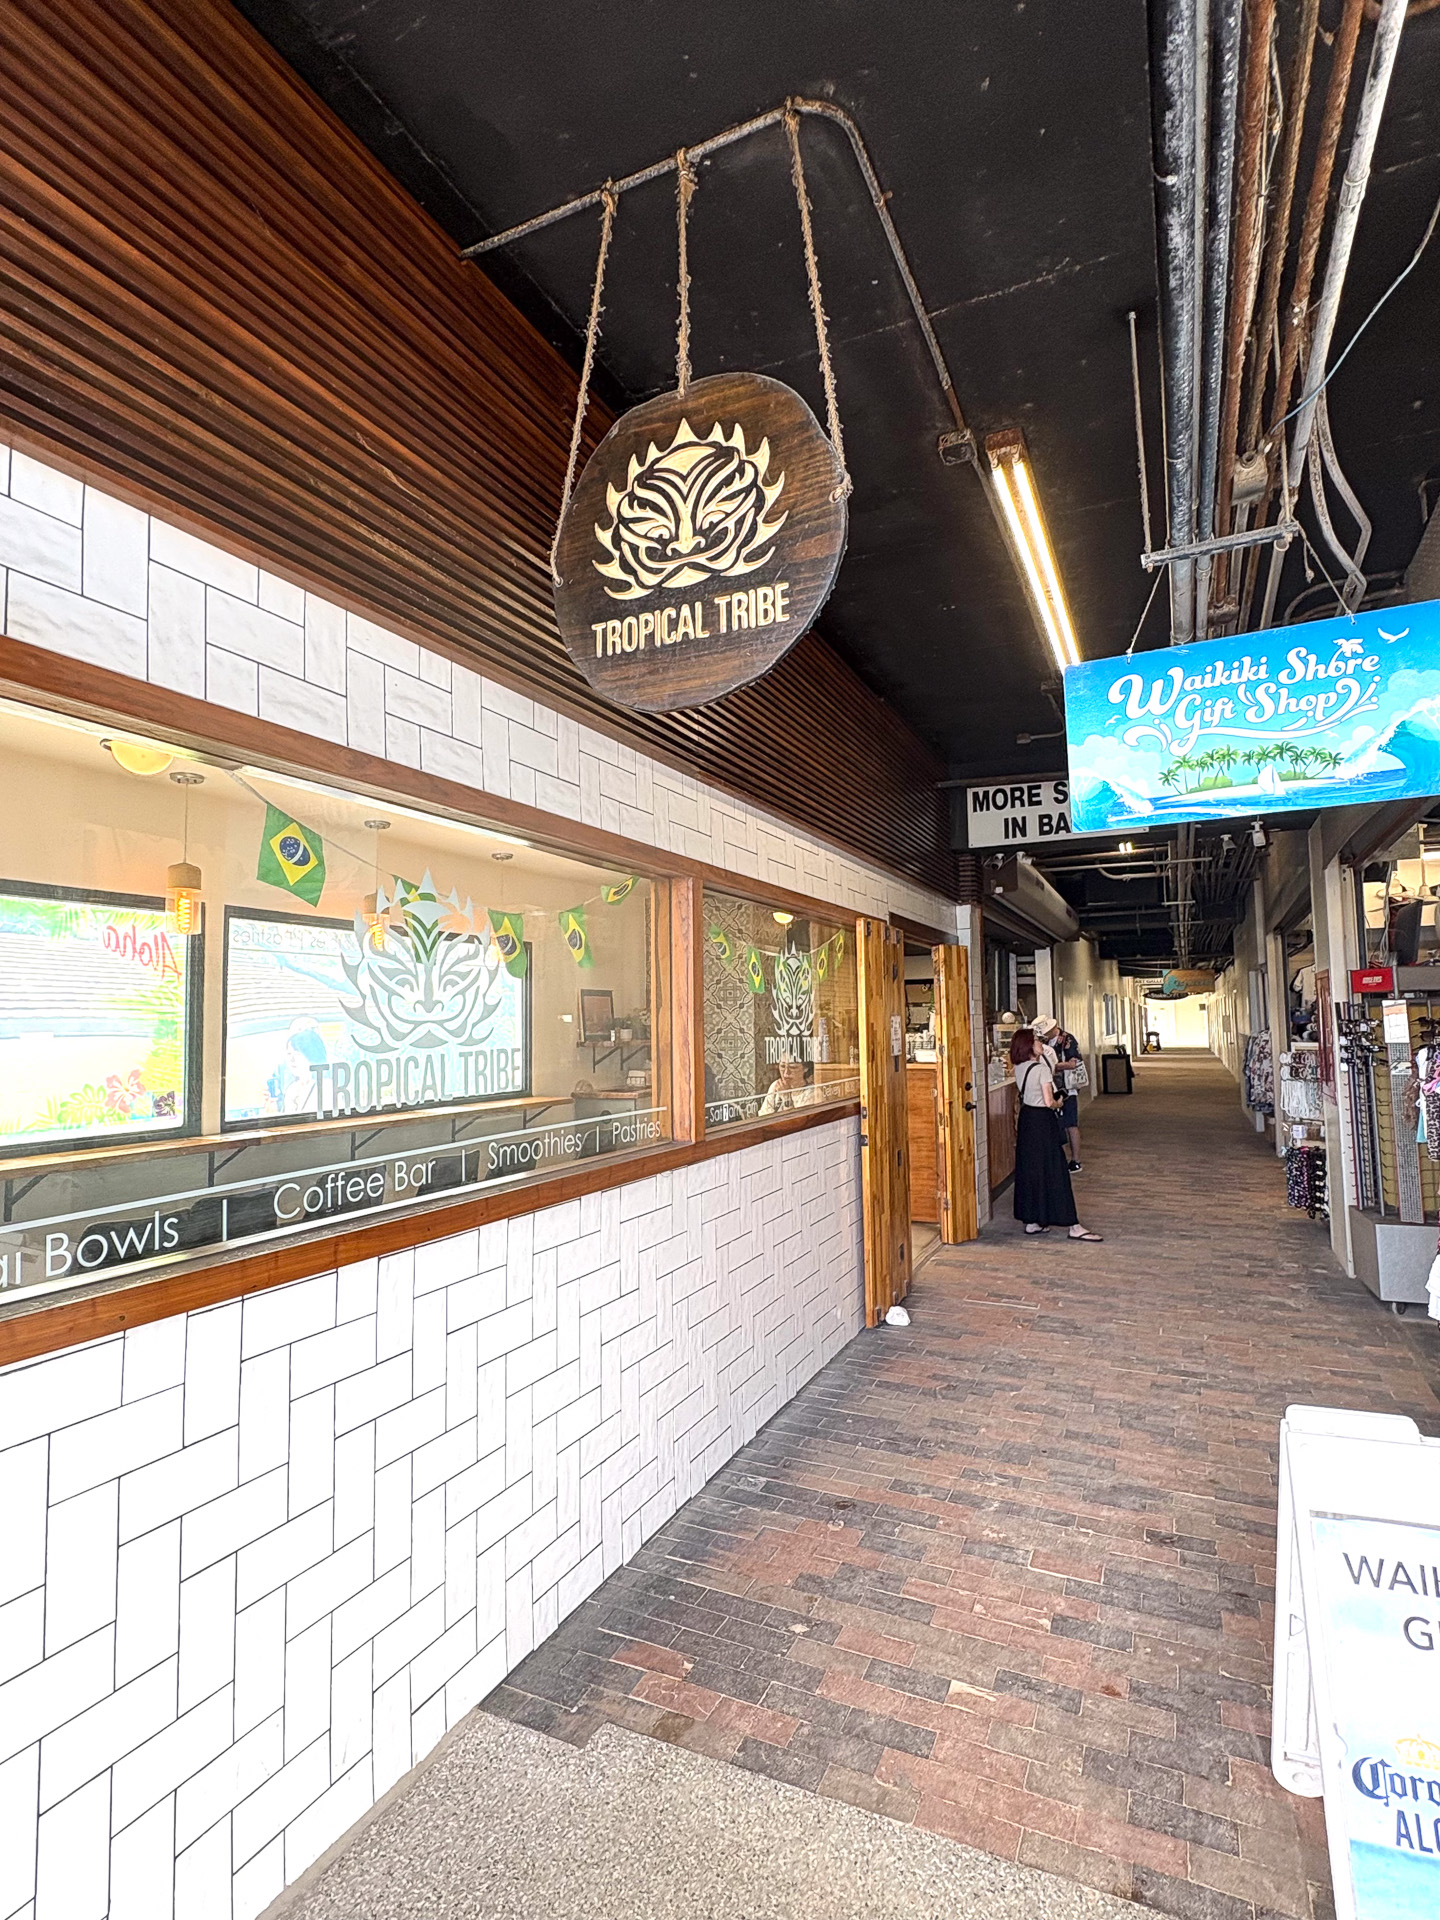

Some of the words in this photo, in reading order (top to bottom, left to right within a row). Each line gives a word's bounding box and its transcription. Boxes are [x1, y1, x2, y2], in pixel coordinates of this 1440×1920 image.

[591, 602, 710, 658] TROPICAL
[714, 582, 790, 633] TRIBE
[1107, 656, 1269, 720] Waikiki
[1278, 646, 1381, 684] Shore
[1169, 694, 1237, 756] Gift
[1244, 678, 1361, 726] Shop
[972, 784, 1042, 813] MORE
[1004, 816, 1027, 839] IN
[309, 1053, 453, 1119] TROPICAL
[459, 1048, 521, 1097] TRIBE
[764, 1036, 803, 1064] TROPICAL
[45, 1211, 179, 1277] Bowls
[273, 1171, 384, 1219] Coffee
[395, 1160, 436, 1191] Bar
[487, 1135, 582, 1170] Smoothies
[612, 1119, 661, 1144] Pastries
